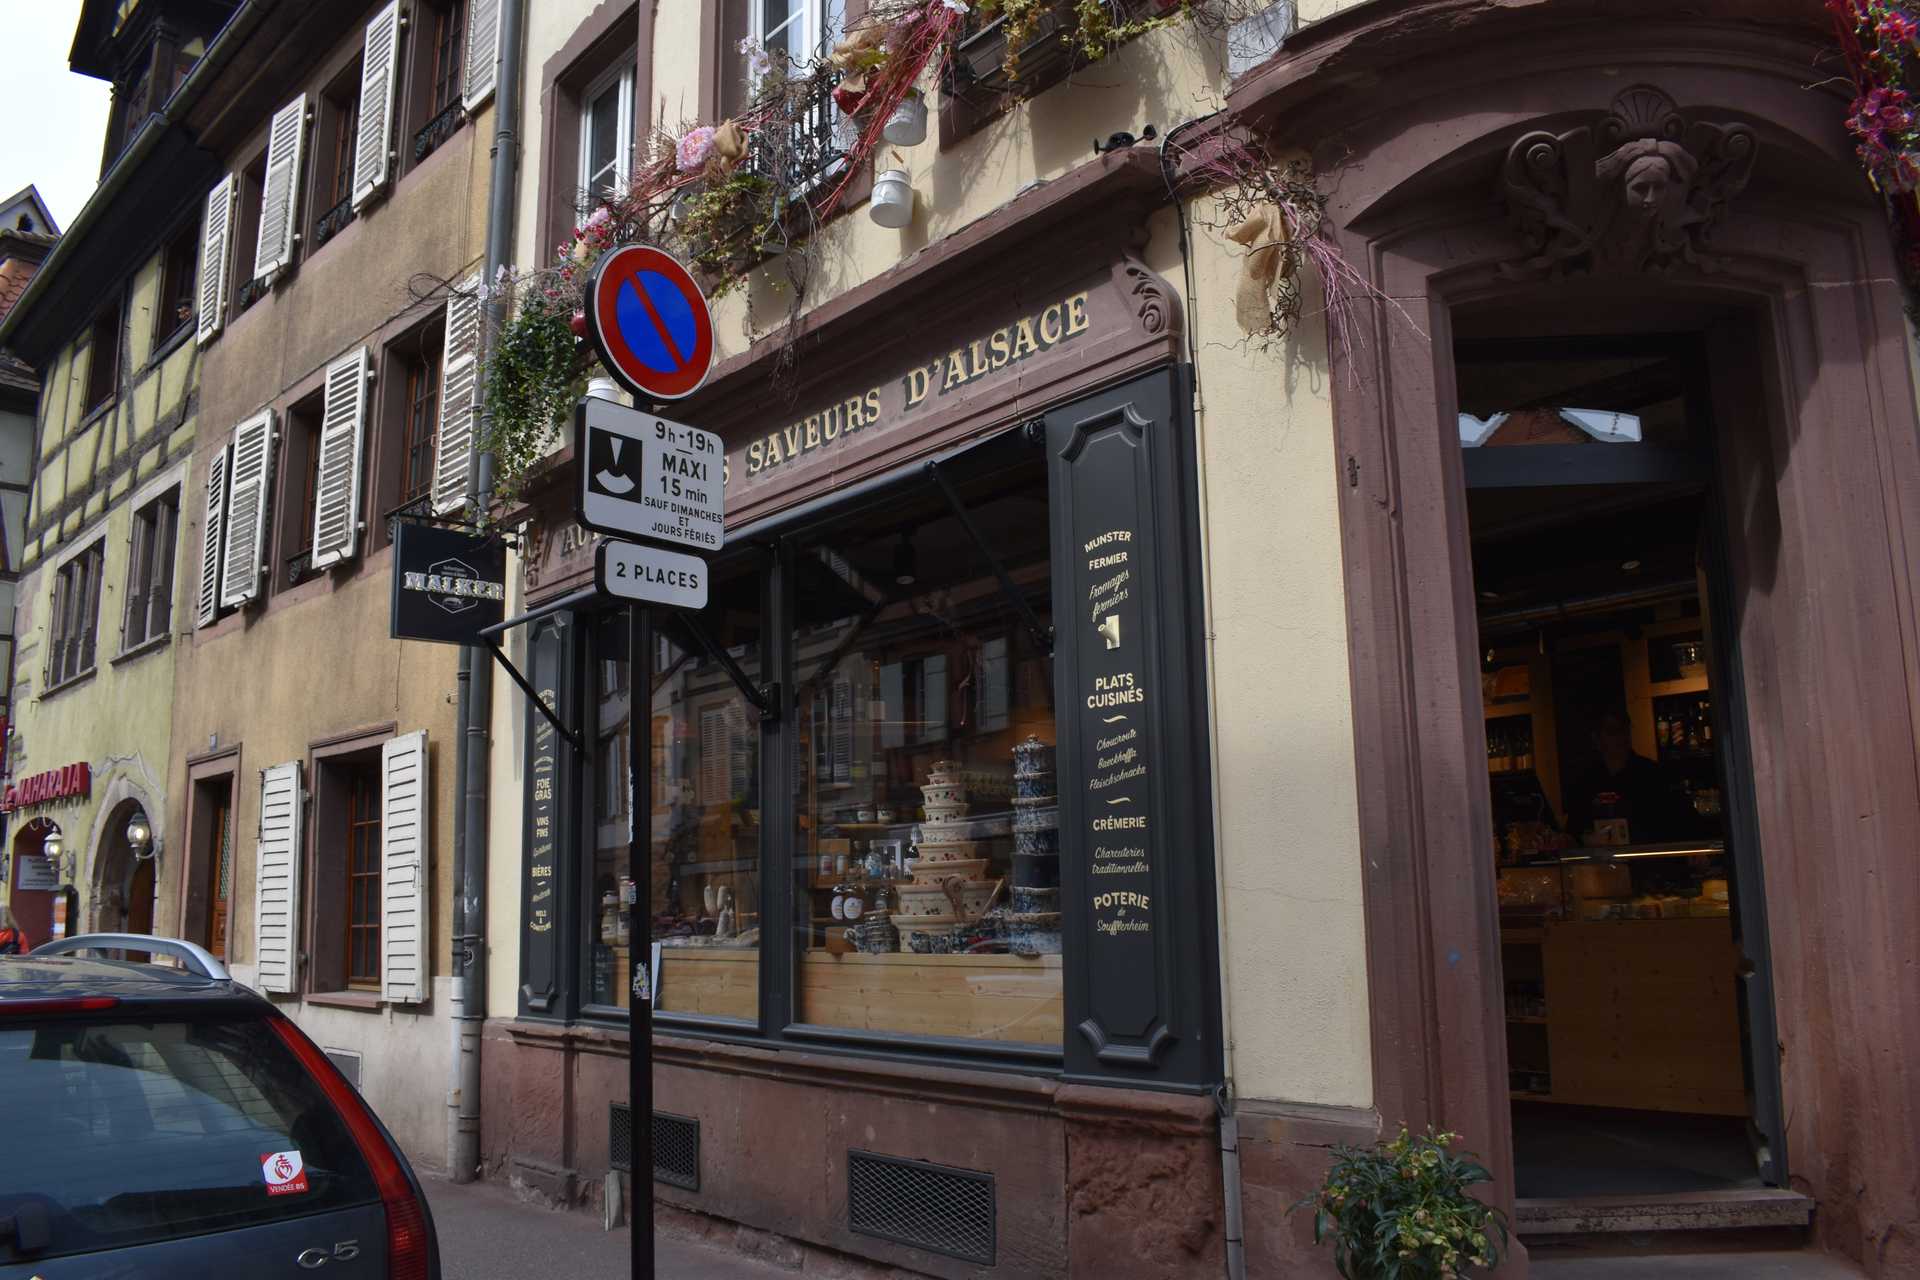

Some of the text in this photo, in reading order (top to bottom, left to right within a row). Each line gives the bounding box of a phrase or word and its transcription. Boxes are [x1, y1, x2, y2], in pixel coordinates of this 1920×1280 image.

[749, 387, 881, 473] SAVEURS
[908, 291, 1089, 405] D'ALSACE
[655, 421, 715, 455] 9h-19h
[662, 453, 707, 481] MAXI
[660, 476, 708, 504] 15 min
[644, 496, 723, 524] SAUF DIMANCHES
[678, 516, 690, 527] ET
[651, 522, 716, 545] JOURS FÉRIÉS
[1084, 530, 1132, 553] MUNSTER
[1088, 552, 1128, 570] FERMIER
[616, 562, 699, 589] 2 PLACES
[1089, 569, 1130, 600] Fromages
[1091, 588, 1129, 623] fermiers
[1095, 672, 1134, 691] PLATS
[1087, 685, 1144, 709] CUISINÉS
[1096, 728, 1137, 751] Choucroute
[16, 765, 81, 808] MAHARAJA
[536, 777, 551, 789] FOIE
[534, 789, 552, 801] GRAS
[536, 815, 550, 827] VINS
[1093, 815, 1147, 831] CRÉMERIE
[536, 827, 549, 838] FINS
[1094, 846, 1145, 859] Charcuteries
[532, 864, 552, 877] BIÈRES
[1092, 861, 1149, 874] traditionnelles
[1093, 891, 1150, 910] POTERIE
[1096, 918, 1149, 936] Soufflenheim
